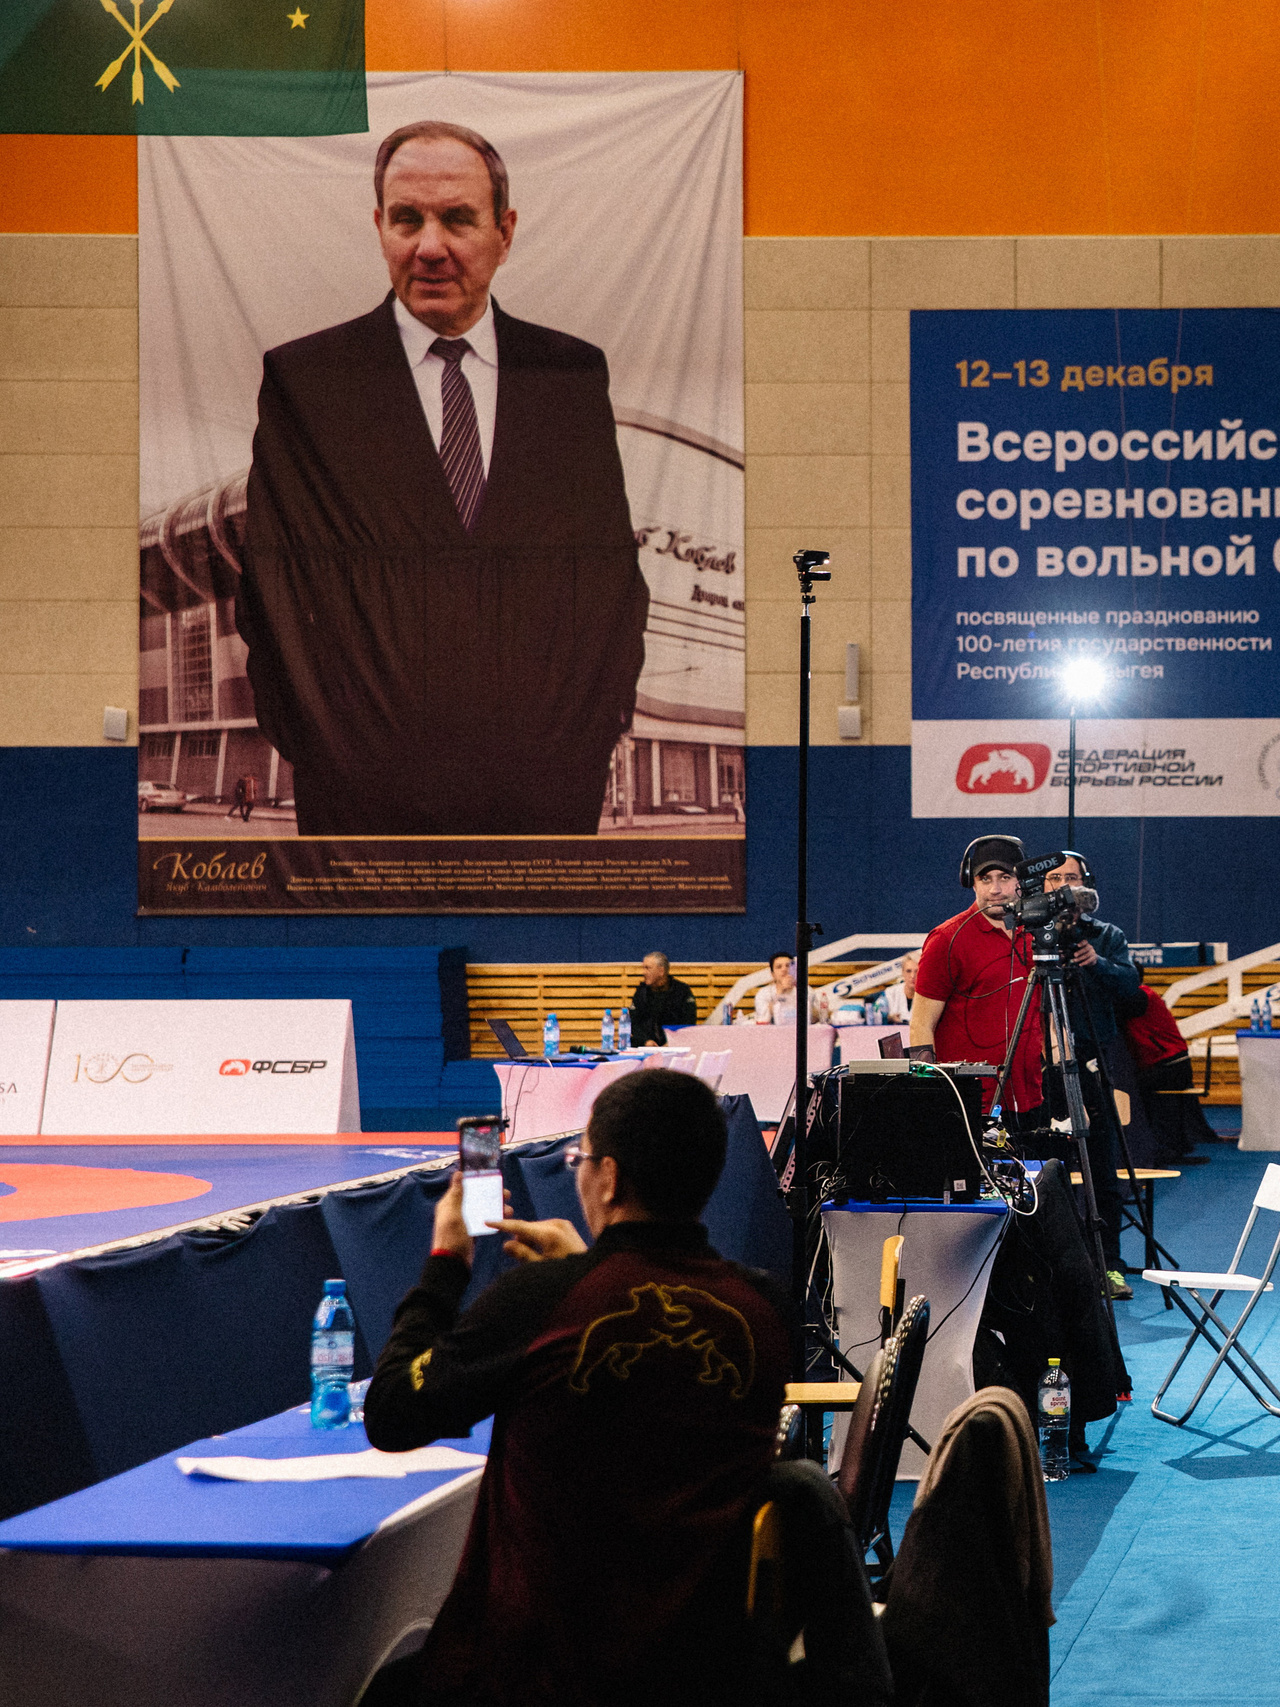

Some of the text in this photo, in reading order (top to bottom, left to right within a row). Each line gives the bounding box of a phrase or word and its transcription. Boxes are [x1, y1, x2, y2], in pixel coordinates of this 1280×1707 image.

[1060, 357, 1214, 393] декабря
[957, 546, 1019, 579] по
[1036, 535, 1257, 578] вольной
[956, 609, 1260, 627] посвященные празднованию
[956, 635, 1273, 657] 100-летия государственности
[1057, 749, 1186, 762] ФЕДЕРАЦИЯ
[1054, 760, 1196, 773] СПОРТИВНОЙ
[1138, 774, 1224, 787] РОССИИ
[152, 851, 268, 880] Коблев
[1027, 857, 1059, 875] RØDE
[251, 1060, 328, 1074] ФСБР
